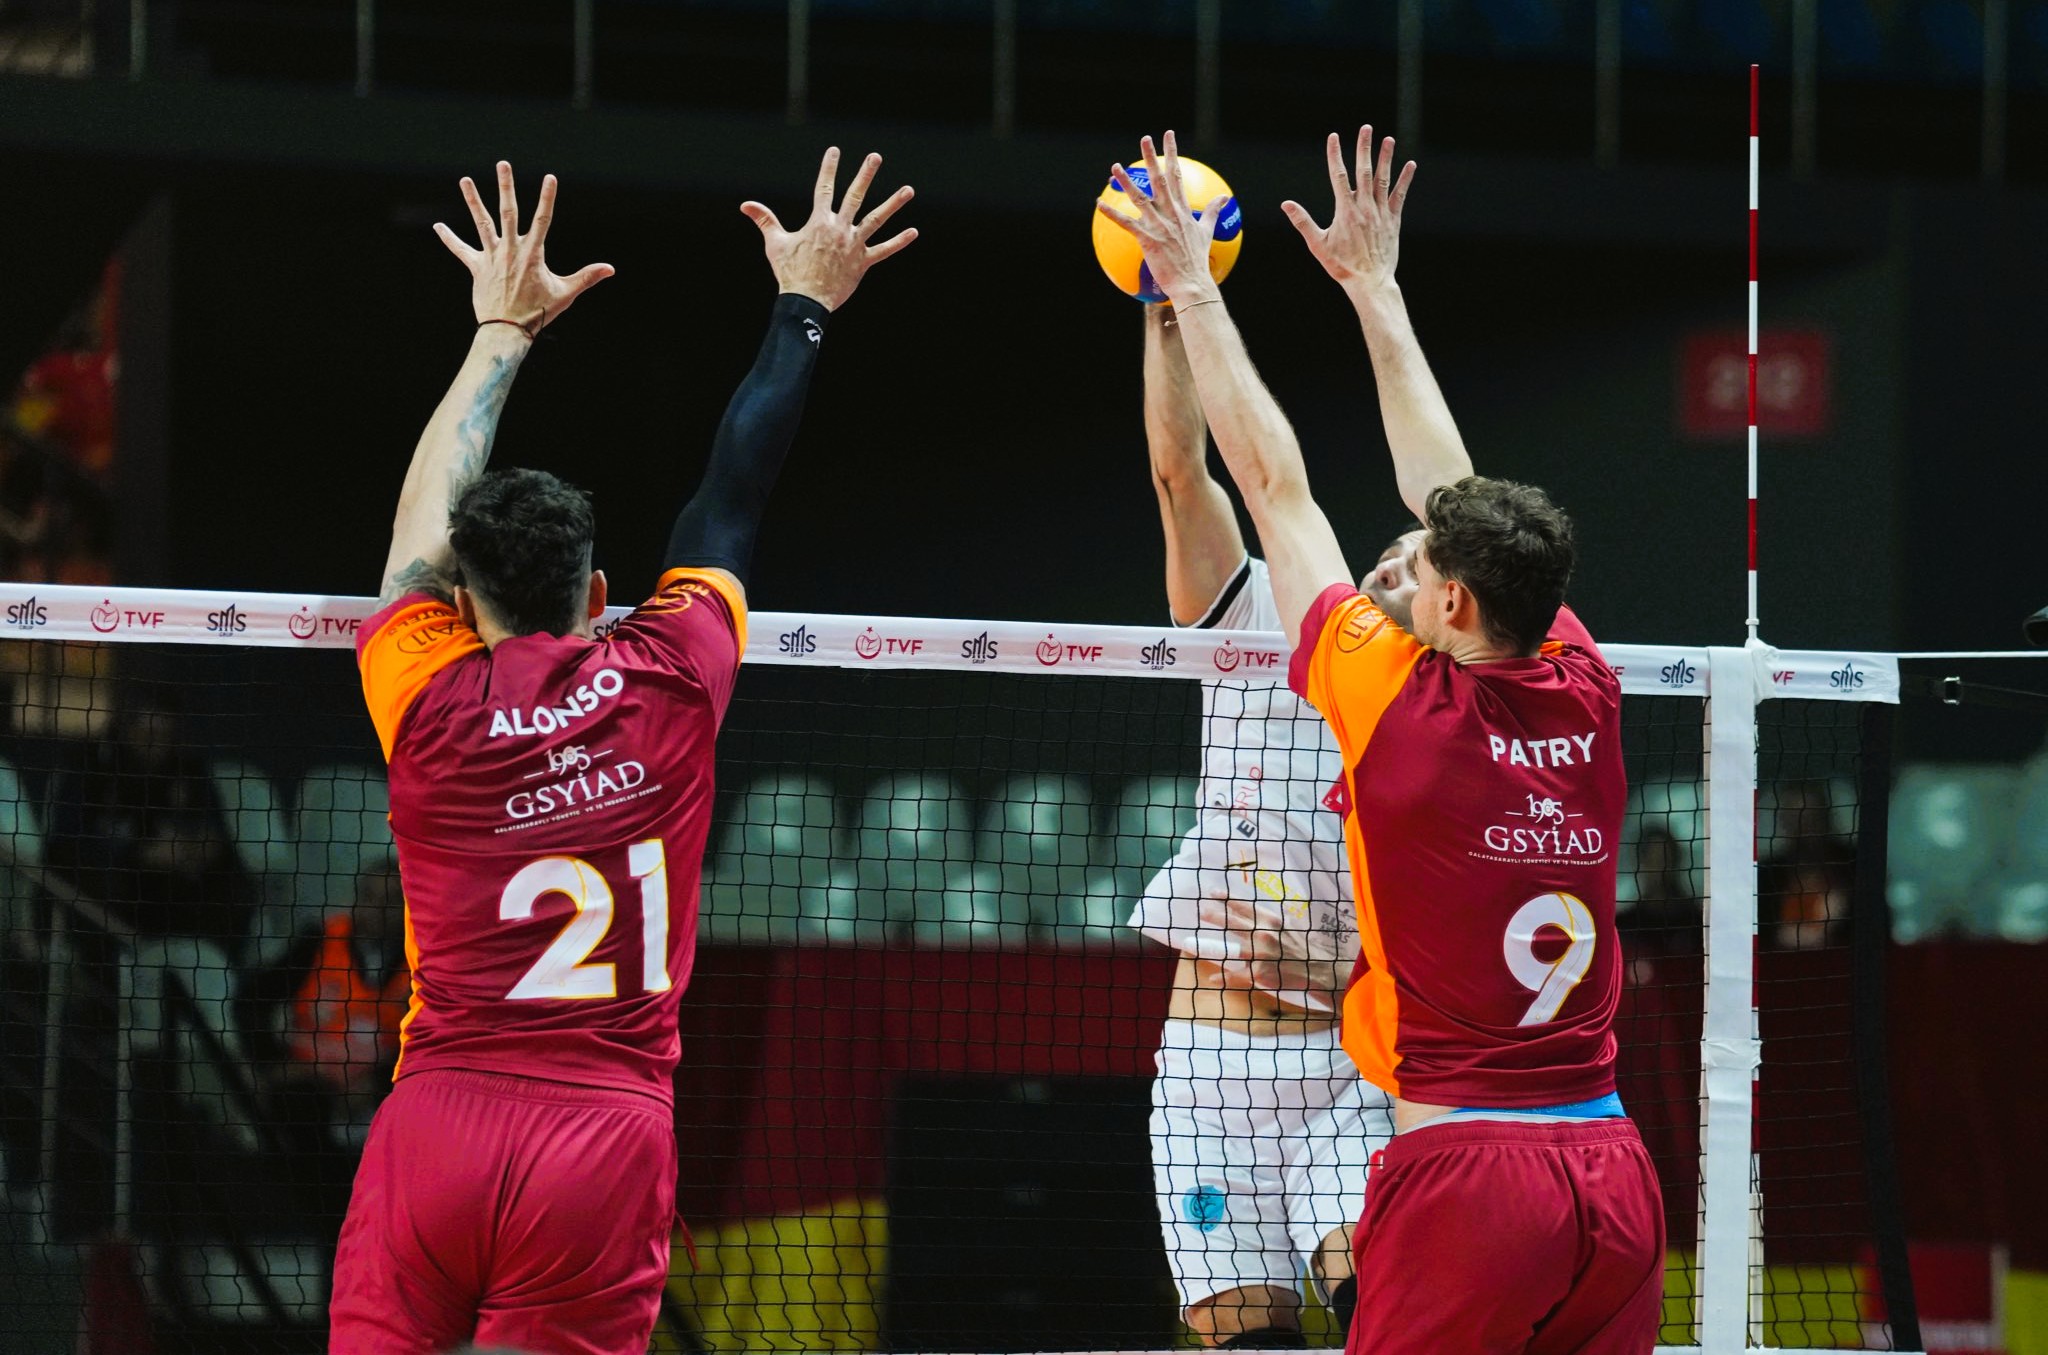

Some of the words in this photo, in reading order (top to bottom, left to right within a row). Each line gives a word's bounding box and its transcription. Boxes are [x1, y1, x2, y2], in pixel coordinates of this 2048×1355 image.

[7, 596, 47, 625] SMS
[124, 612, 165, 628] TVF
[206, 603, 247, 632] SMS
[322, 618, 362, 636] TVF
[594, 617, 620, 640] SM
[779, 624, 817, 653] SMS
[886, 639, 924, 655] TVF
[961, 631, 999, 660] SMS
[1066, 645, 1103, 661] TVF
[1140, 637, 1177, 666] SMS
[1243, 652, 1280, 668] TVF
[1660, 658, 1695, 684] SMS
[1829, 661, 1864, 688] SMS
[489, 668, 625, 738] ALONSO
[1489, 731, 1597, 768] PATRY
[505, 760, 646, 819] GSYİAD
[1484, 825, 1602, 856] GSYİAD
[499, 838, 674, 1001] 21
[1503, 891, 1598, 1028] 9
